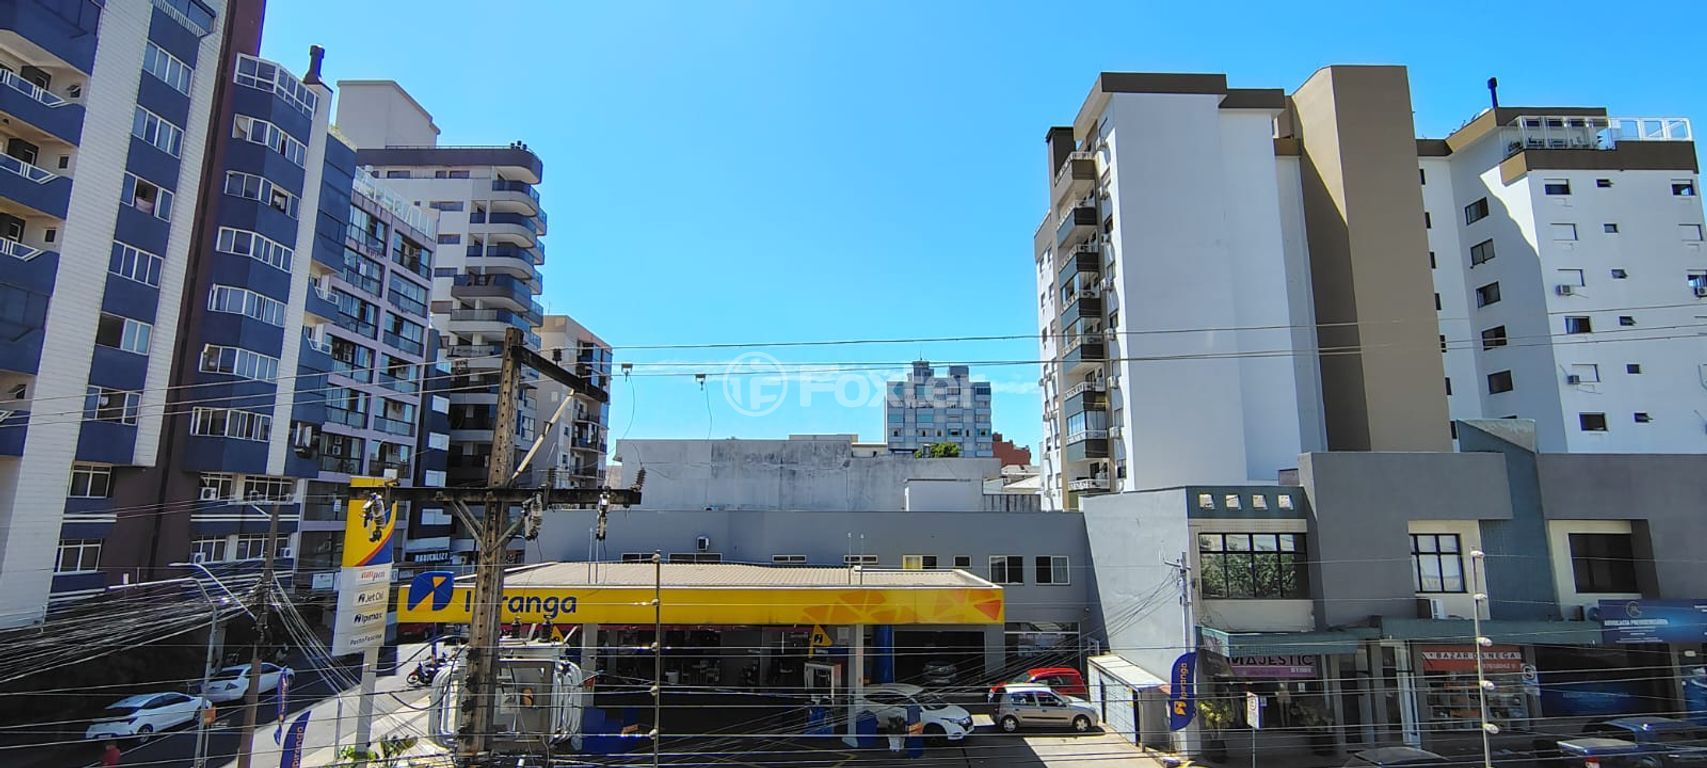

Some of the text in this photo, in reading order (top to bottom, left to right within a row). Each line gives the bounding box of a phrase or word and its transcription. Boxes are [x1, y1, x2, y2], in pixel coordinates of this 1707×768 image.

[465, 590, 577, 619] Ianga
[1227, 654, 1312, 666] MAJESTIC
[290, 726, 304, 768] piranga
